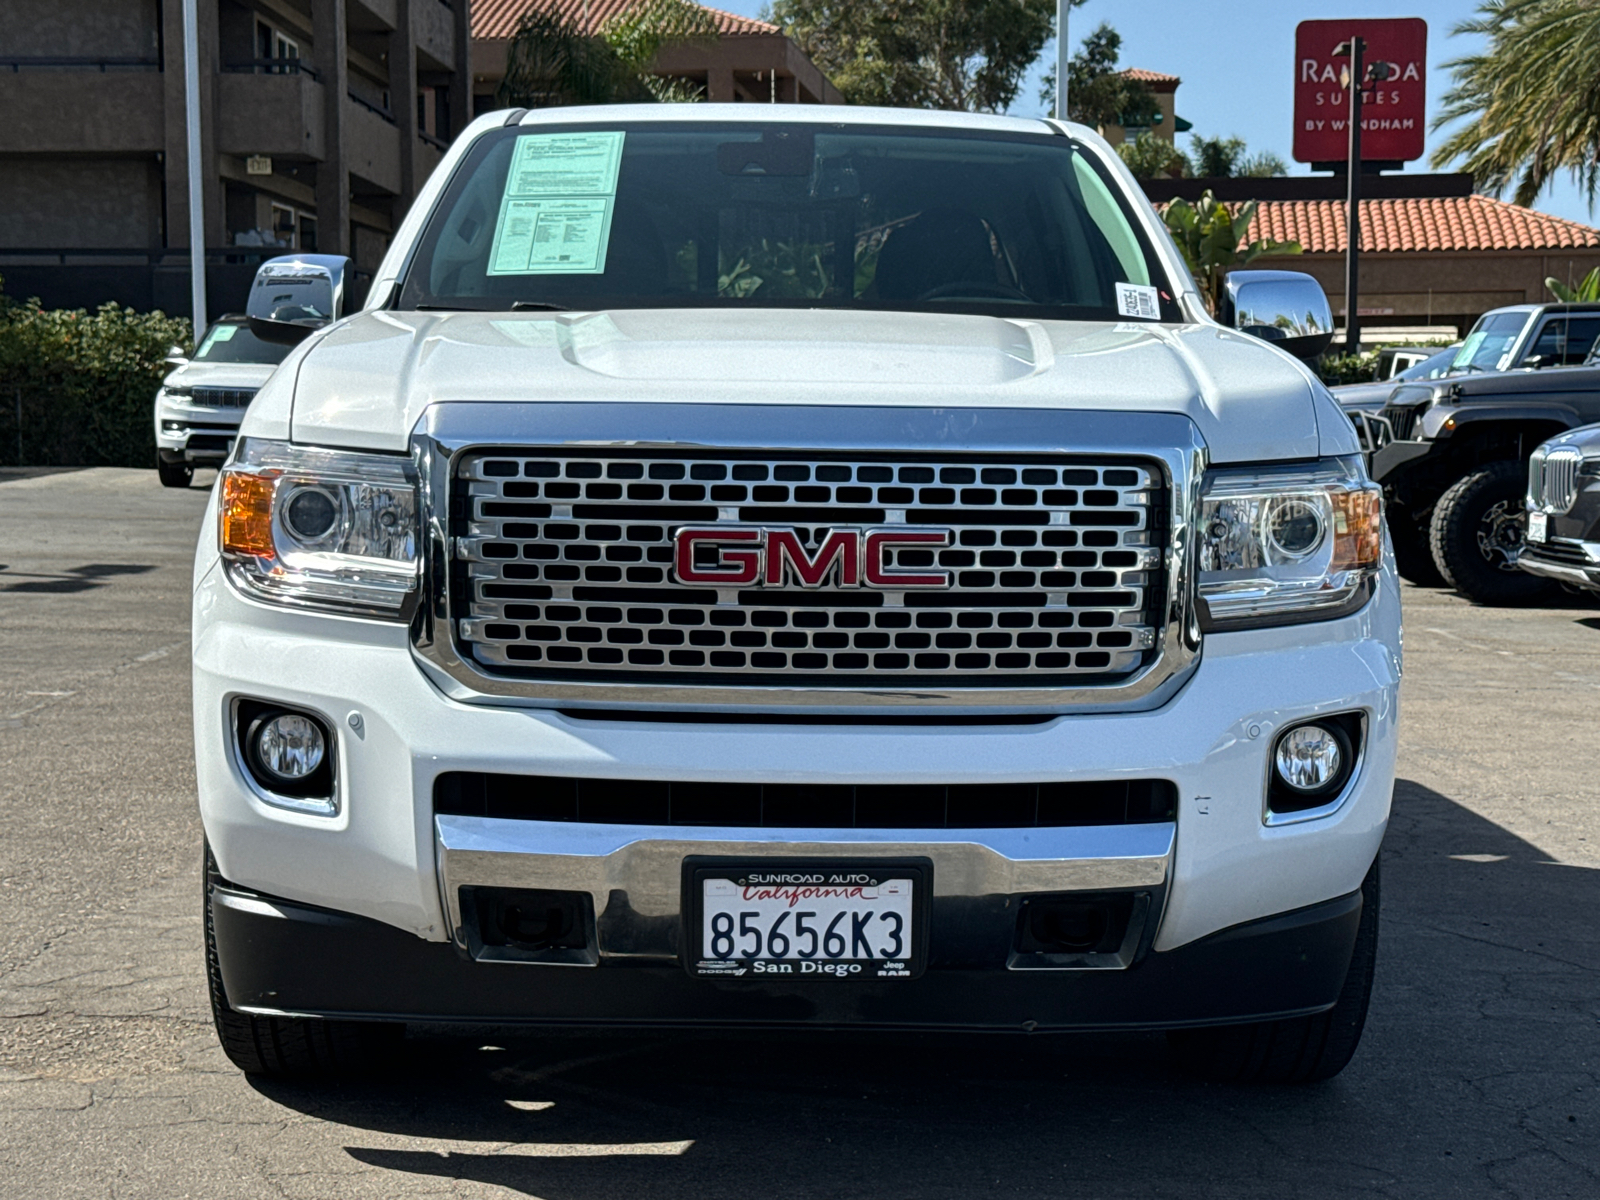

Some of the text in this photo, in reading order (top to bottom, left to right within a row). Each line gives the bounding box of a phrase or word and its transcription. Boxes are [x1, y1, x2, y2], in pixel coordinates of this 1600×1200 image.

[1302, 59, 1419, 82] RADA
[1316, 91, 1400, 105] SUTES
[1305, 119, 1414, 131] BY WNDHAM
[674, 526, 950, 589] GMC
[748, 874, 870, 884] SUNROAD AUTO
[742, 886, 878, 908] California
[711, 911, 904, 959] 85656K3
[753, 961, 862, 977] San Diego
[883, 960, 905, 970] Jeep
